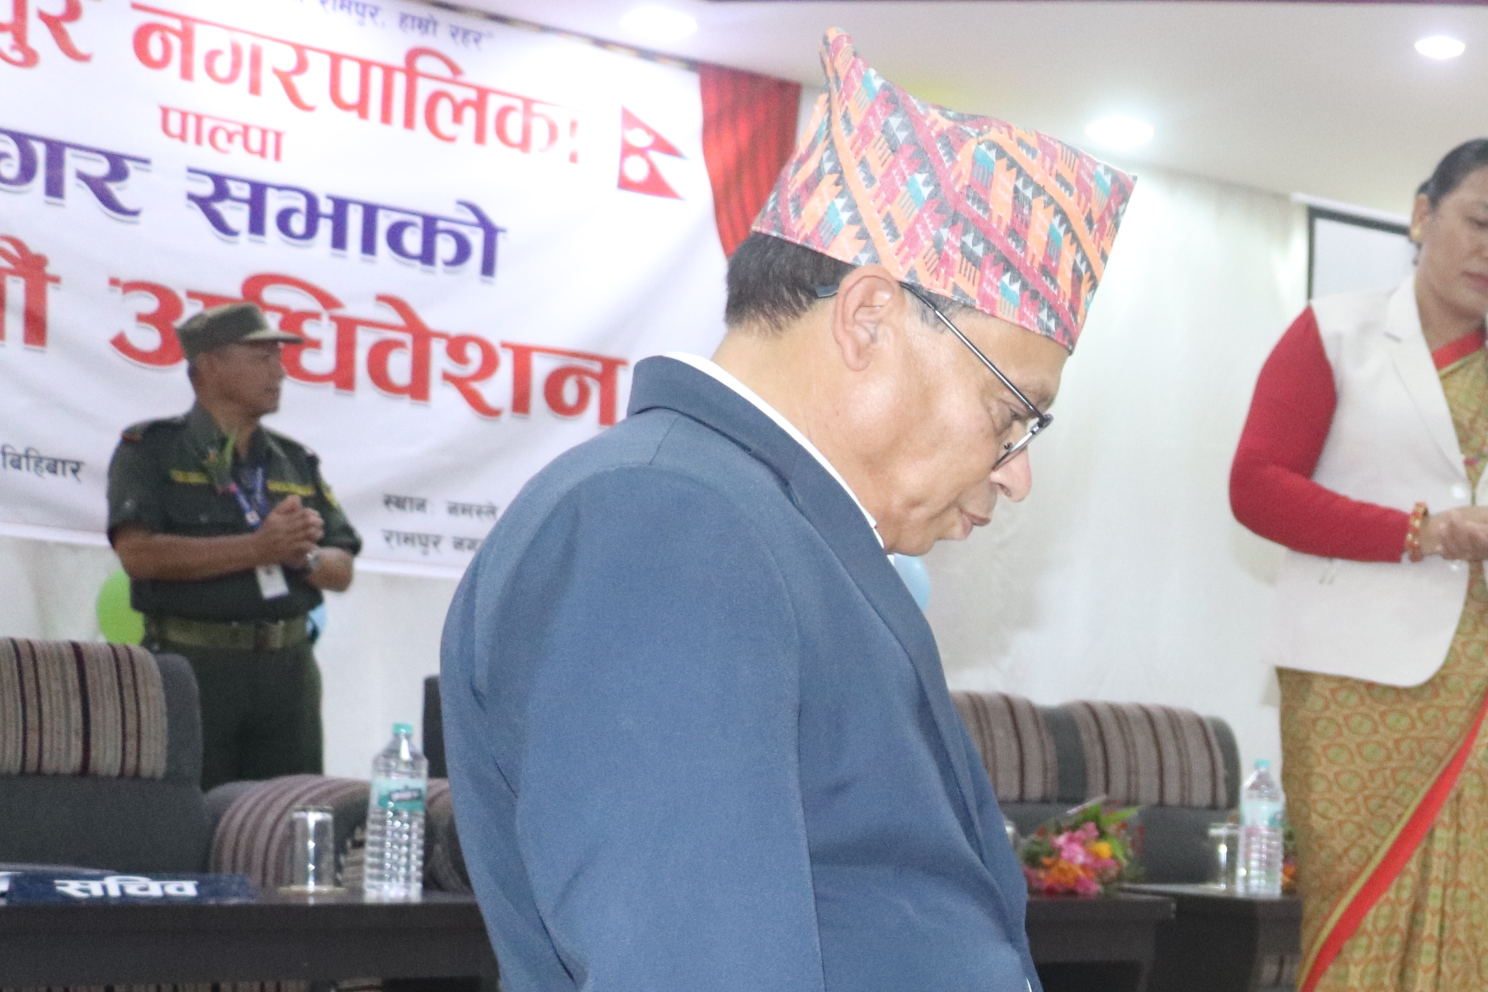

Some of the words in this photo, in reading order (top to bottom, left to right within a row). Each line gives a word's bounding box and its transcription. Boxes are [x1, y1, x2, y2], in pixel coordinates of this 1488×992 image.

[131, 2, 582, 164] नगरपालिका
[158, 104, 285, 162] पाल्पा
[186, 165, 508, 279] सभाको
[381, 529, 443, 556] रामपुर
[54, 875, 199, 898] सचिव
